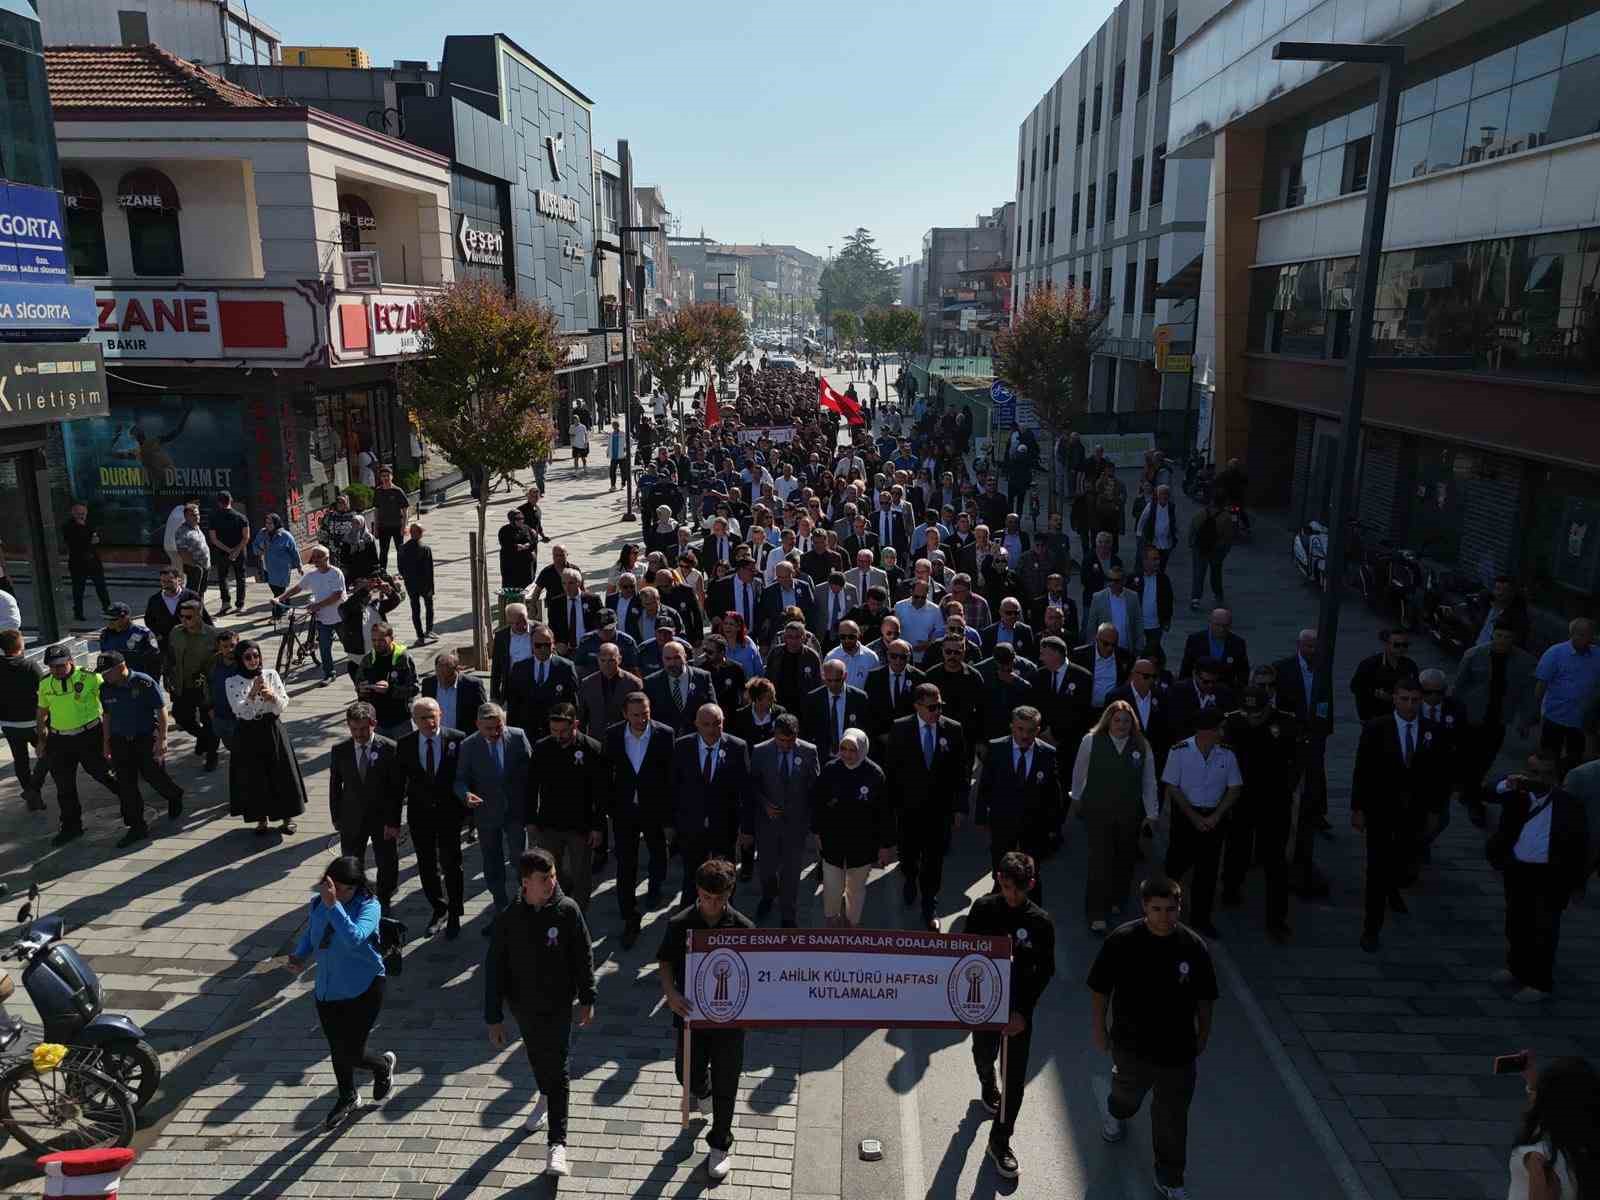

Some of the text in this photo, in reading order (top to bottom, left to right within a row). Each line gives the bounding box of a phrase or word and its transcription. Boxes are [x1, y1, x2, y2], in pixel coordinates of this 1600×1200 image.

[16, 301, 71, 320] SİGORTA
[107, 339, 147, 350] BAKIR
[17, 388, 101, 411] iletişim
[165, 465, 212, 487] DEVAM
[215, 468, 231, 487] ET
[708, 934, 747, 945] DÜZCE
[750, 935, 788, 945] ESNAF
[791, 935, 806, 945] VE
[808, 935, 893, 947] SANATKARLAR
[896, 937, 948, 949] ODALARI
[779, 969, 820, 983] AHİLİK
[824, 969, 882, 984] KÜLTÜRÜ
[886, 973, 938, 985] HAFTASI
[808, 987, 899, 1000] KUTLAMALARI
